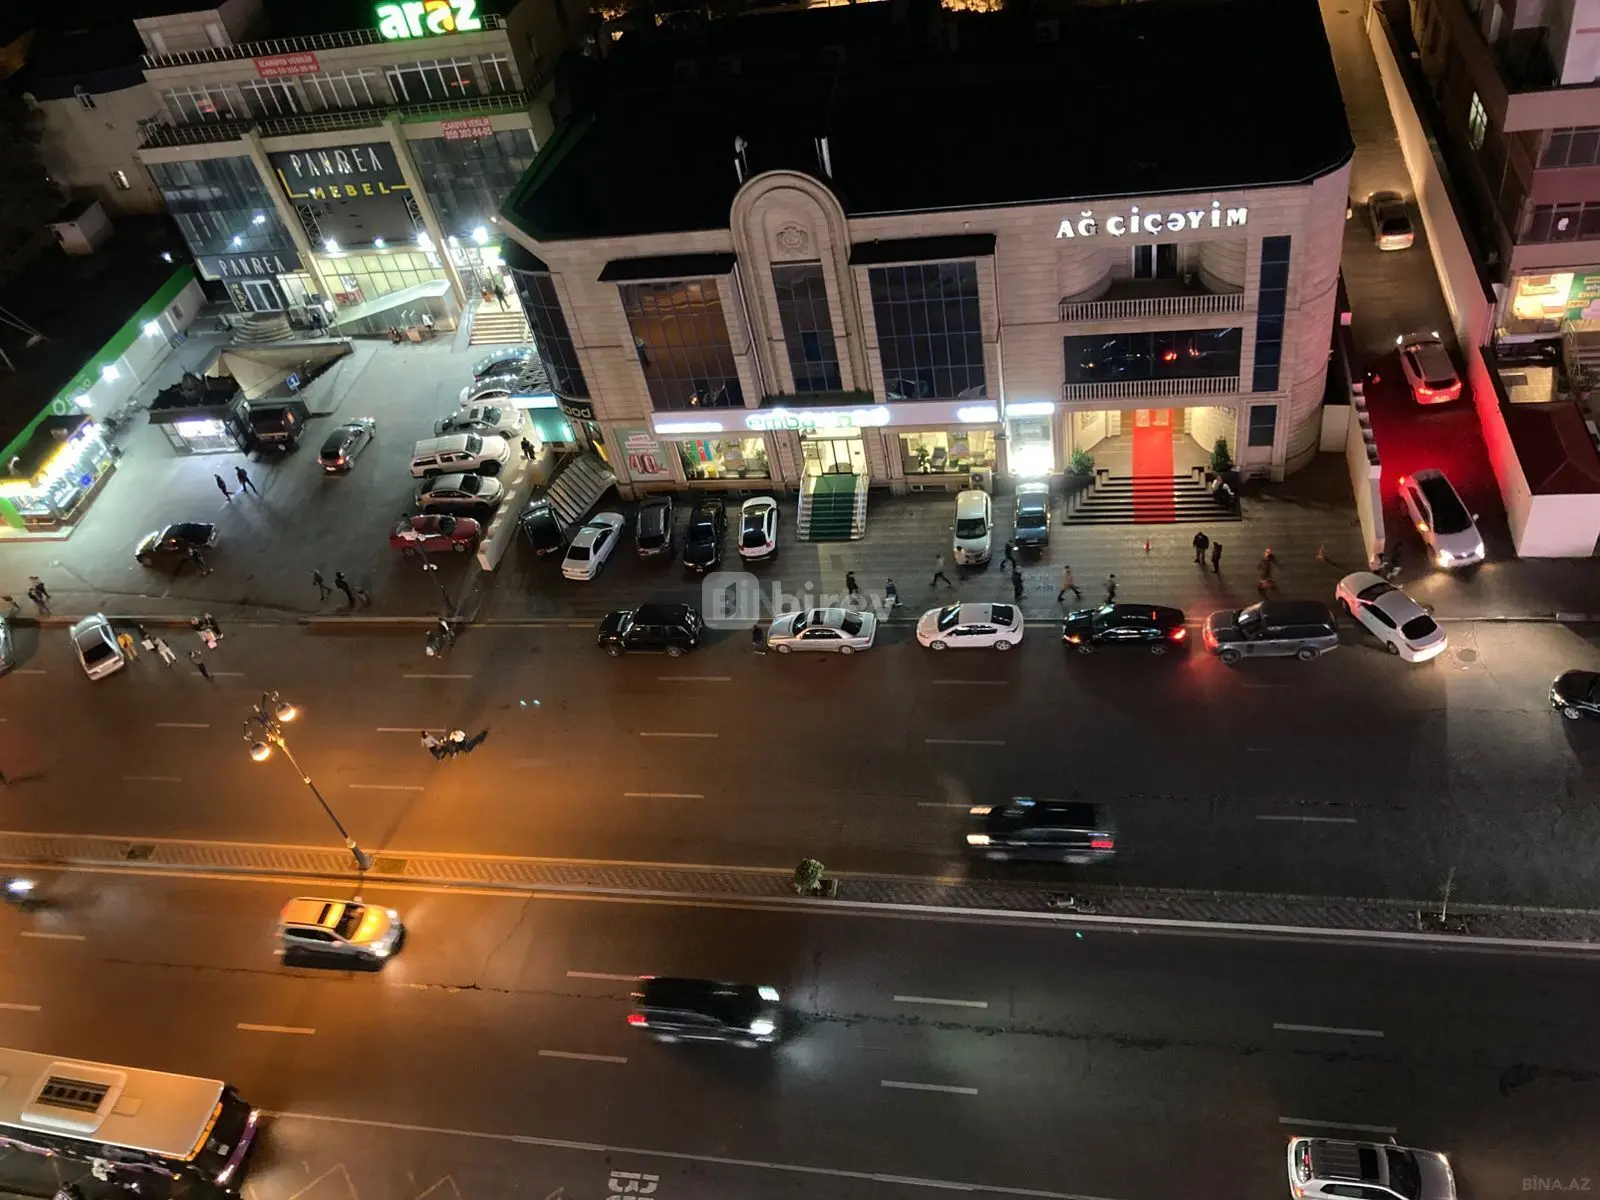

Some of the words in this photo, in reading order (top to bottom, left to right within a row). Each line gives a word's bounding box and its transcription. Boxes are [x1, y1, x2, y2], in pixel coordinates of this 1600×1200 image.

[375, 0, 482, 39] araz
[309, 182, 391, 200] MEBEL
[1055, 210, 1097, 239] AĞ
[1106, 200, 1248, 237] ÇİÇƏYİM
